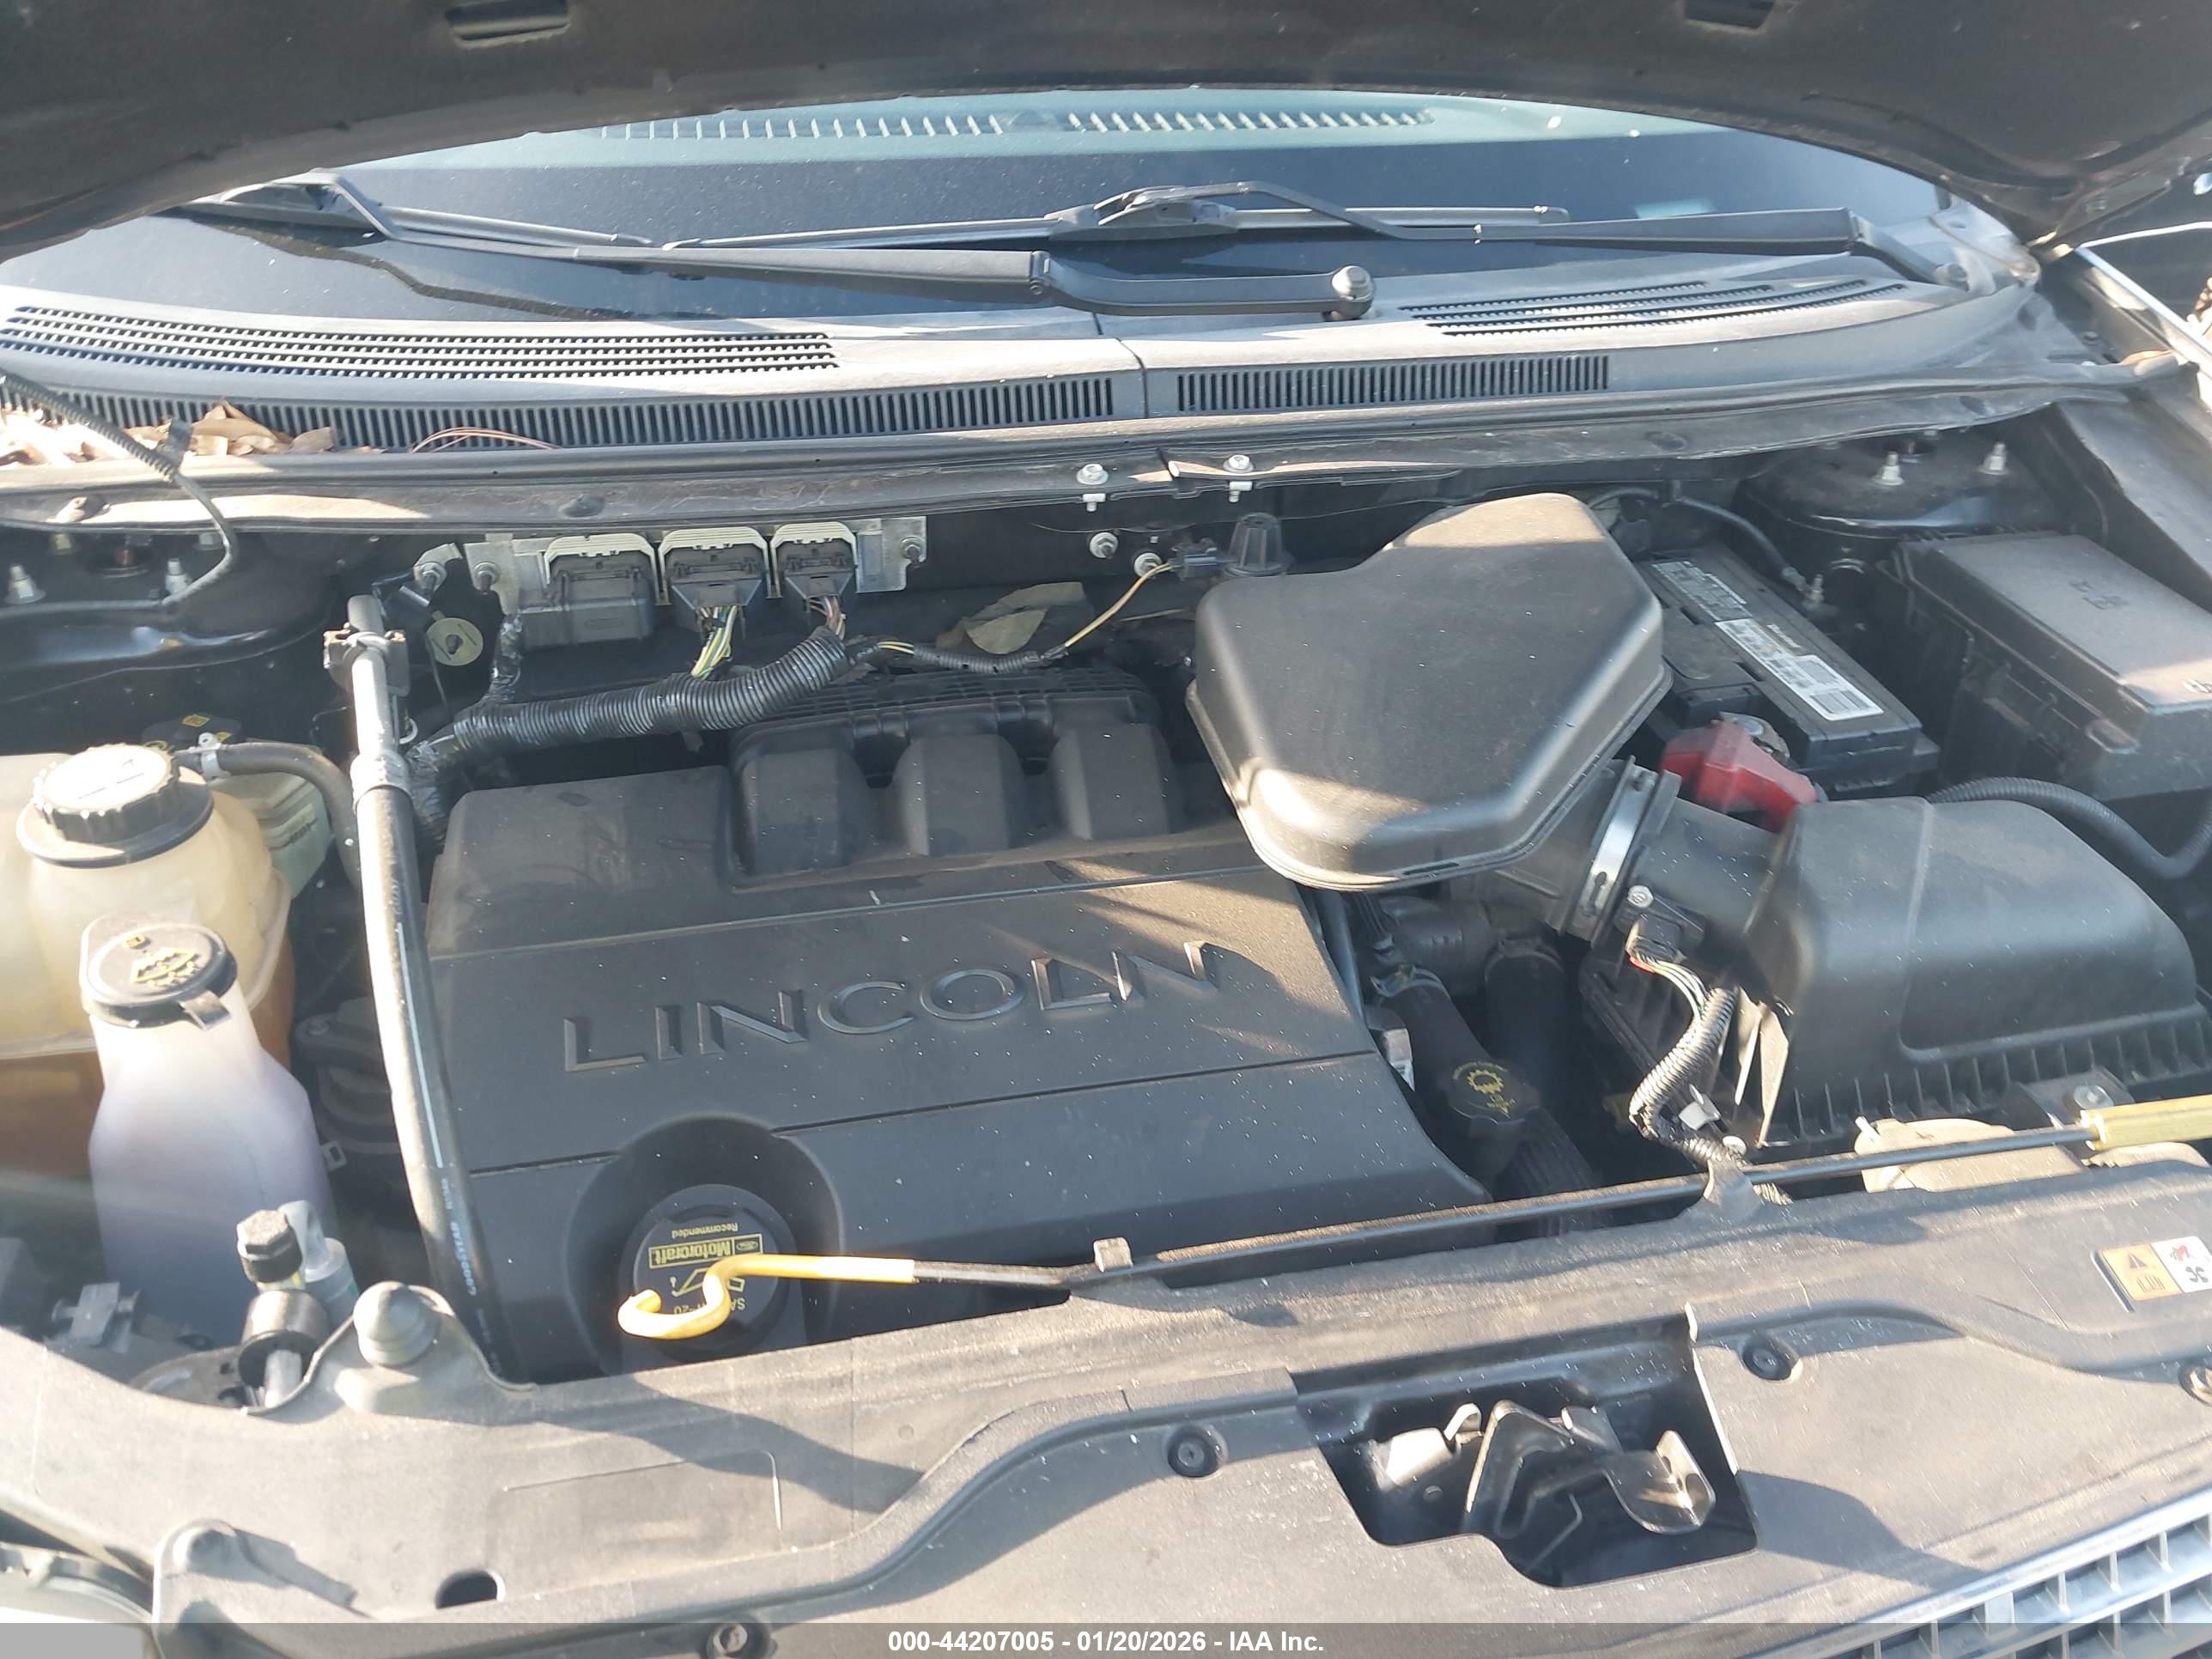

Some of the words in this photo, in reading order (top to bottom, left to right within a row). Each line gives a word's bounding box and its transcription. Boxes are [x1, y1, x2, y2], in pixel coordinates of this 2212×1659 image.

[563, 940, 1219, 1073] LINCOLN
[671, 1222, 738, 1239] Recommended
[654, 1240, 732, 1265] Motorcraft
